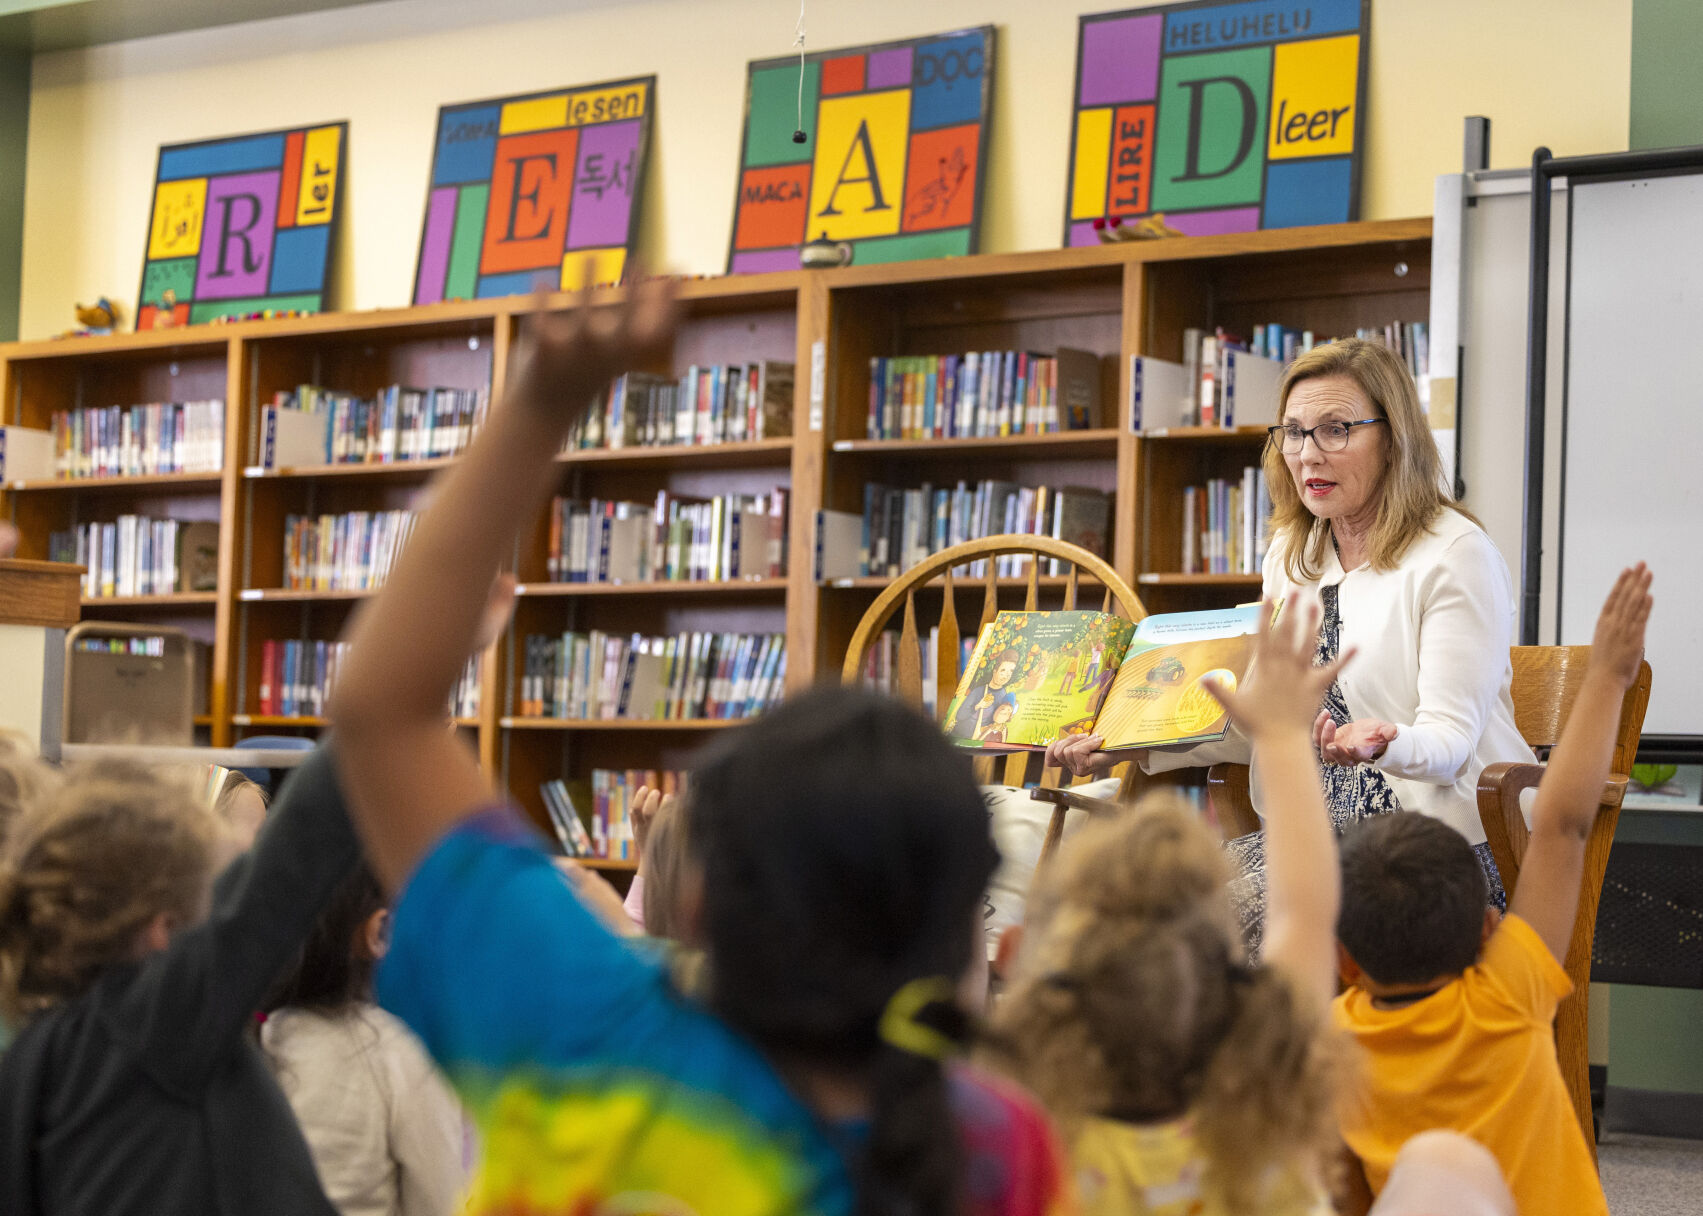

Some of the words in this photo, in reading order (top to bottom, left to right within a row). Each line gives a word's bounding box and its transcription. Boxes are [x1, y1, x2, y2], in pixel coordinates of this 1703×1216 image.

[566, 89, 639, 126] lesen
[1171, 75, 1258, 183] D
[1276, 99, 1350, 145] leer
[303, 162, 330, 216] ler
[498, 152, 558, 244] E
[576, 149, 636, 201] 독서
[817, 118, 892, 217] A
[1116, 117, 1144, 208] LIRE
[207, 191, 264, 279] R
